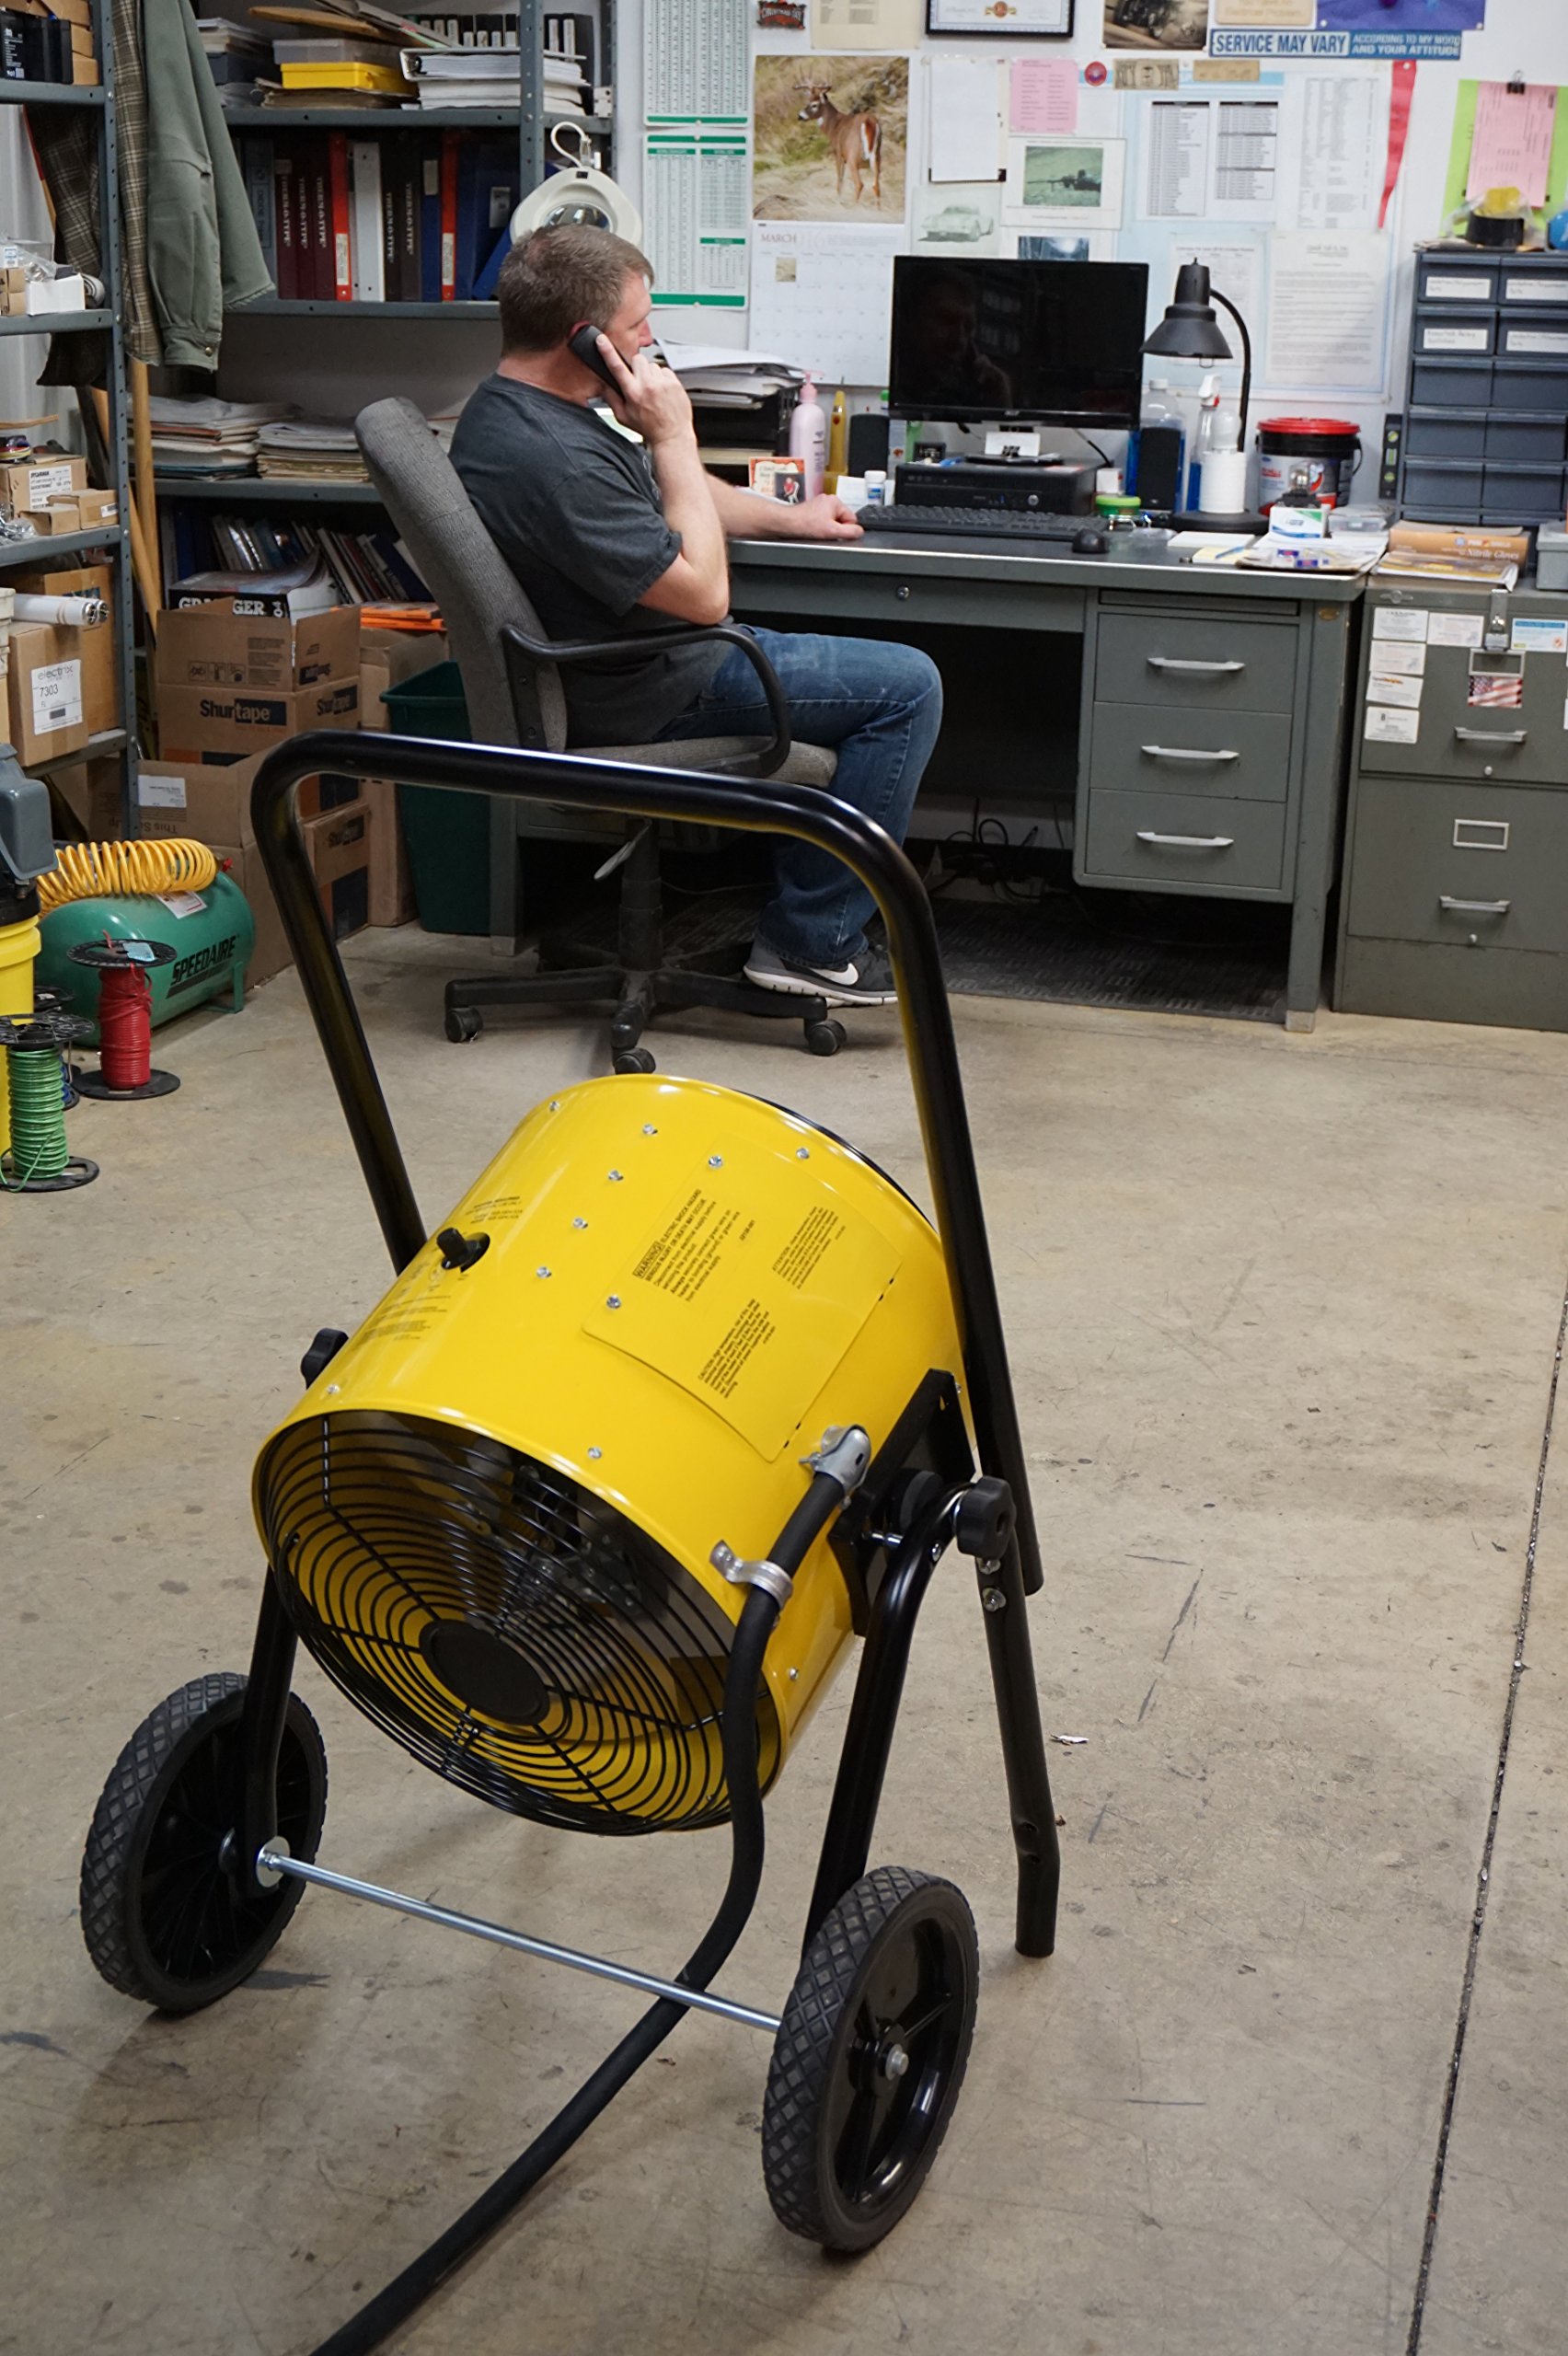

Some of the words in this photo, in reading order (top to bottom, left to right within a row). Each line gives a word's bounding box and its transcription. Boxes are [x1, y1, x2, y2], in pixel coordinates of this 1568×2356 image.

[1216, 34, 1273, 52] SERVICE
[1277, 36, 1306, 52] MAY
[1310, 35, 1345, 53] VARY
[1352, 34, 1404, 44] ACCORDING
[1405, 36, 1417, 44] TO
[1419, 36, 1433, 44] MY
[1352, 45, 1376, 54] AND
[1378, 46, 1406, 55] YOUR
[1409, 46, 1460, 56] ATTITUDE
[760, 234, 797, 244] MARCH
[38, 665, 74, 680] electrix
[40, 683, 59, 698] 7303
[200, 699, 271, 722] Shurtape
[170, 935, 236, 986] SPEEDAIRE
